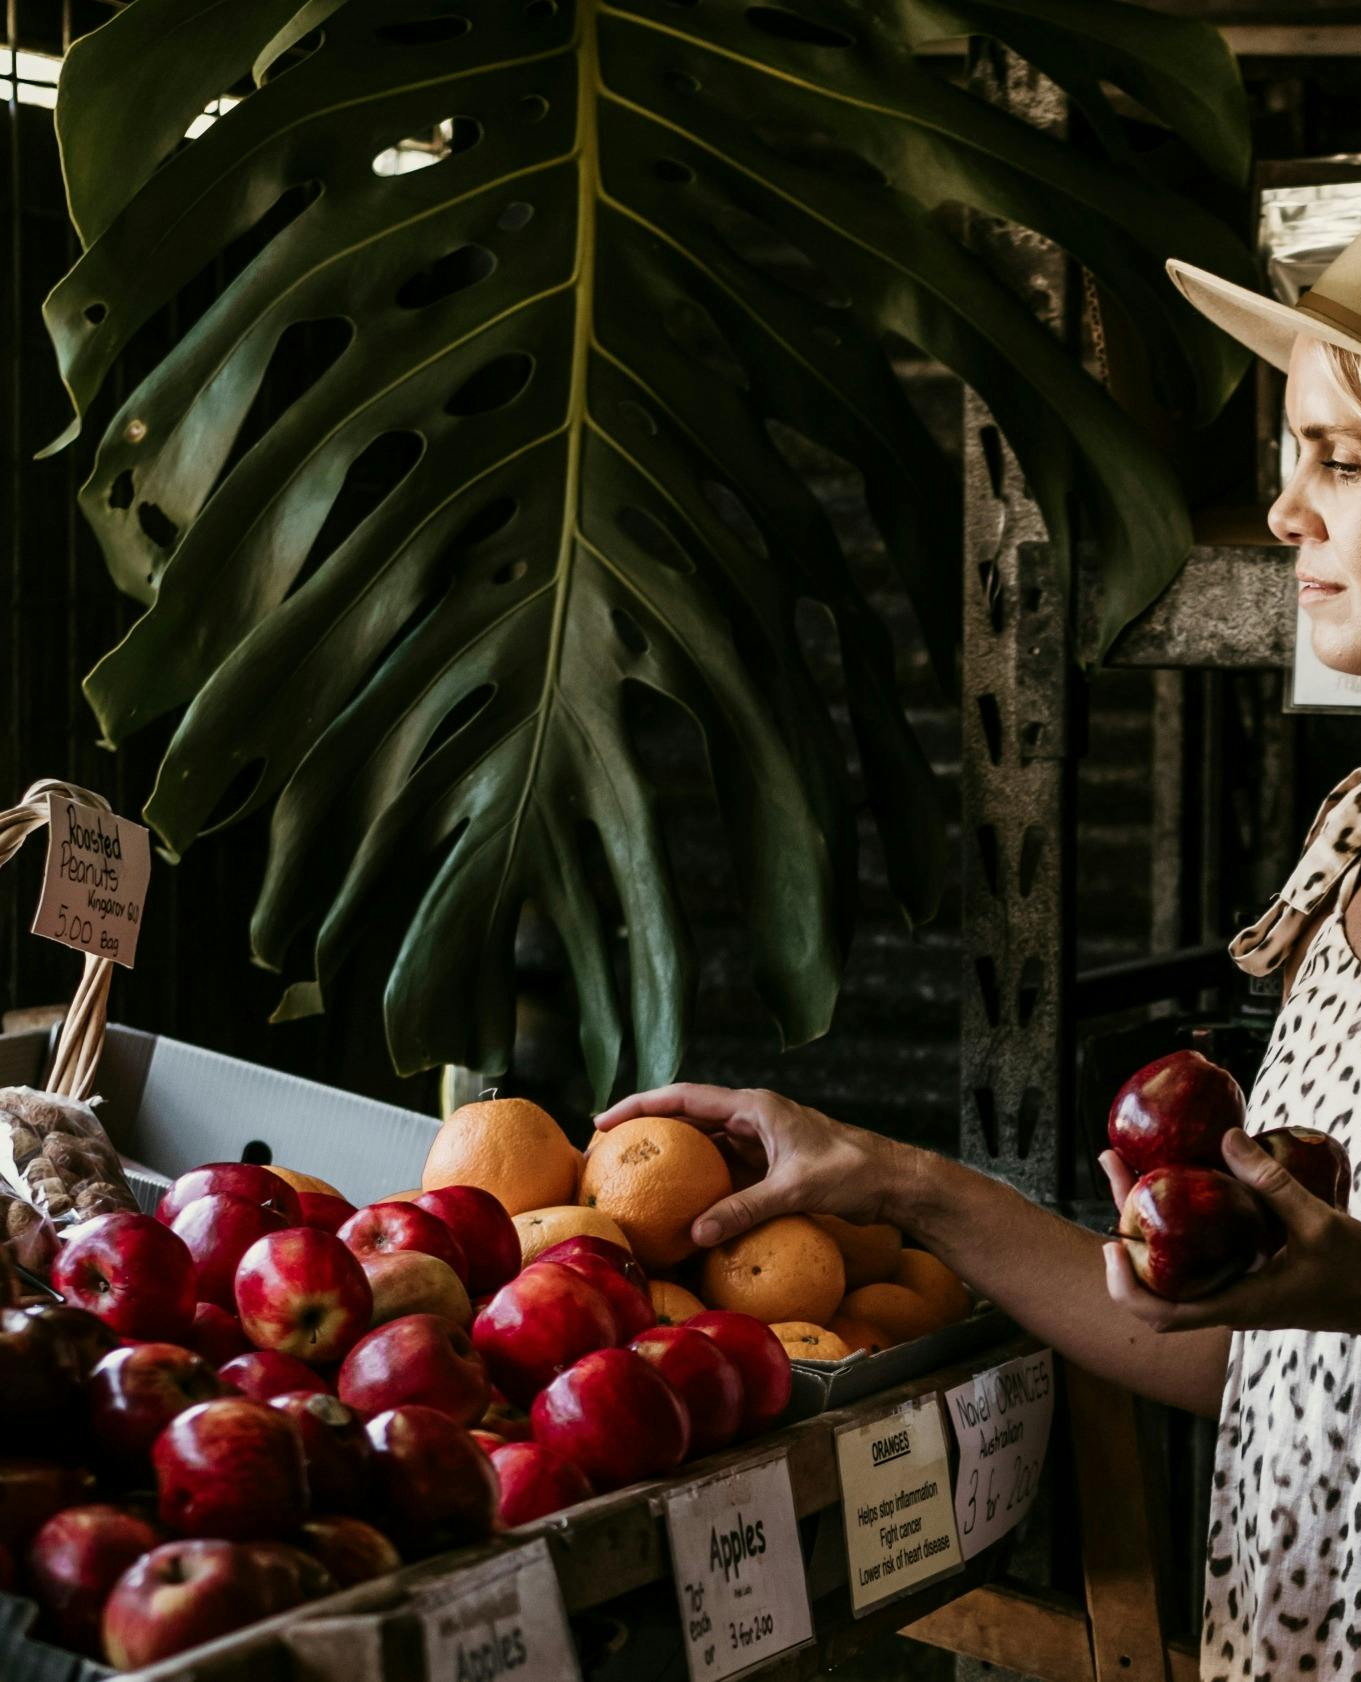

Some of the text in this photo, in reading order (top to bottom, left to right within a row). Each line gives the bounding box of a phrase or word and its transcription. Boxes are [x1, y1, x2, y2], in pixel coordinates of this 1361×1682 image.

[66, 804, 122, 860] Roasted
[60, 840, 118, 892] Peanuts
[54, 904, 119, 957] 5.00 Bag
[872, 1430, 911, 1462] ORANGES
[857, 1481, 938, 1528] Helps stop inflammation
[964, 1469, 979, 1535] 3
[709, 1512, 767, 1583] Apples
[880, 1516, 922, 1550] Fight cancer
[859, 1534, 951, 1587] Lower risk of heart disease
[729, 1622, 738, 1649] 3
